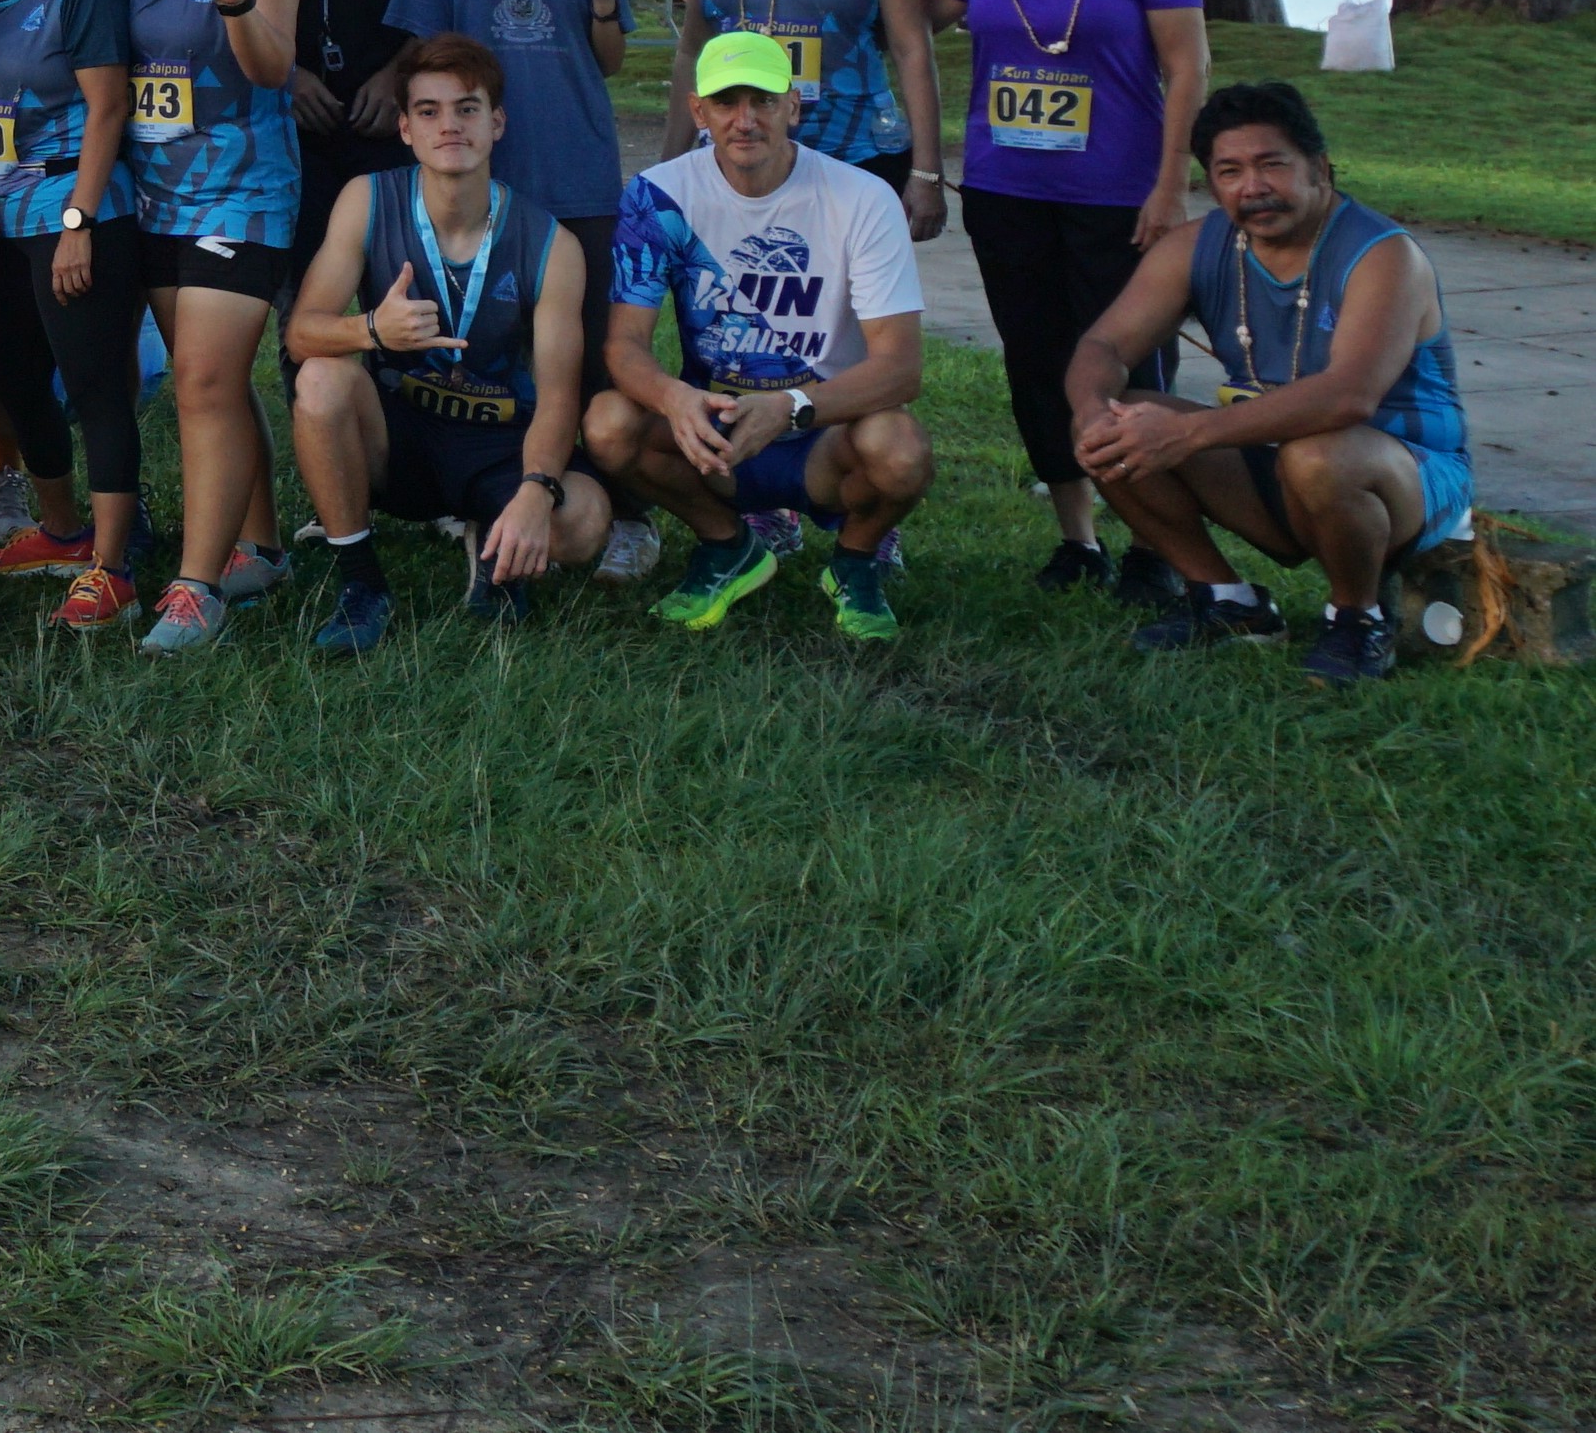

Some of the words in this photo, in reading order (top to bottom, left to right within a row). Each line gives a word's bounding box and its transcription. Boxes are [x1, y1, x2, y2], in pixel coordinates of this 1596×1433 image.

[771, 21, 818, 35] Saipan
[149, 62, 187, 76] Saipan
[1036, 69, 1088, 84] Saipan
[997, 86, 1079, 127] 042
[692, 270, 824, 317] RUN
[721, 326, 828, 358] SAIPAN
[760, 371, 811, 388] Saipan
